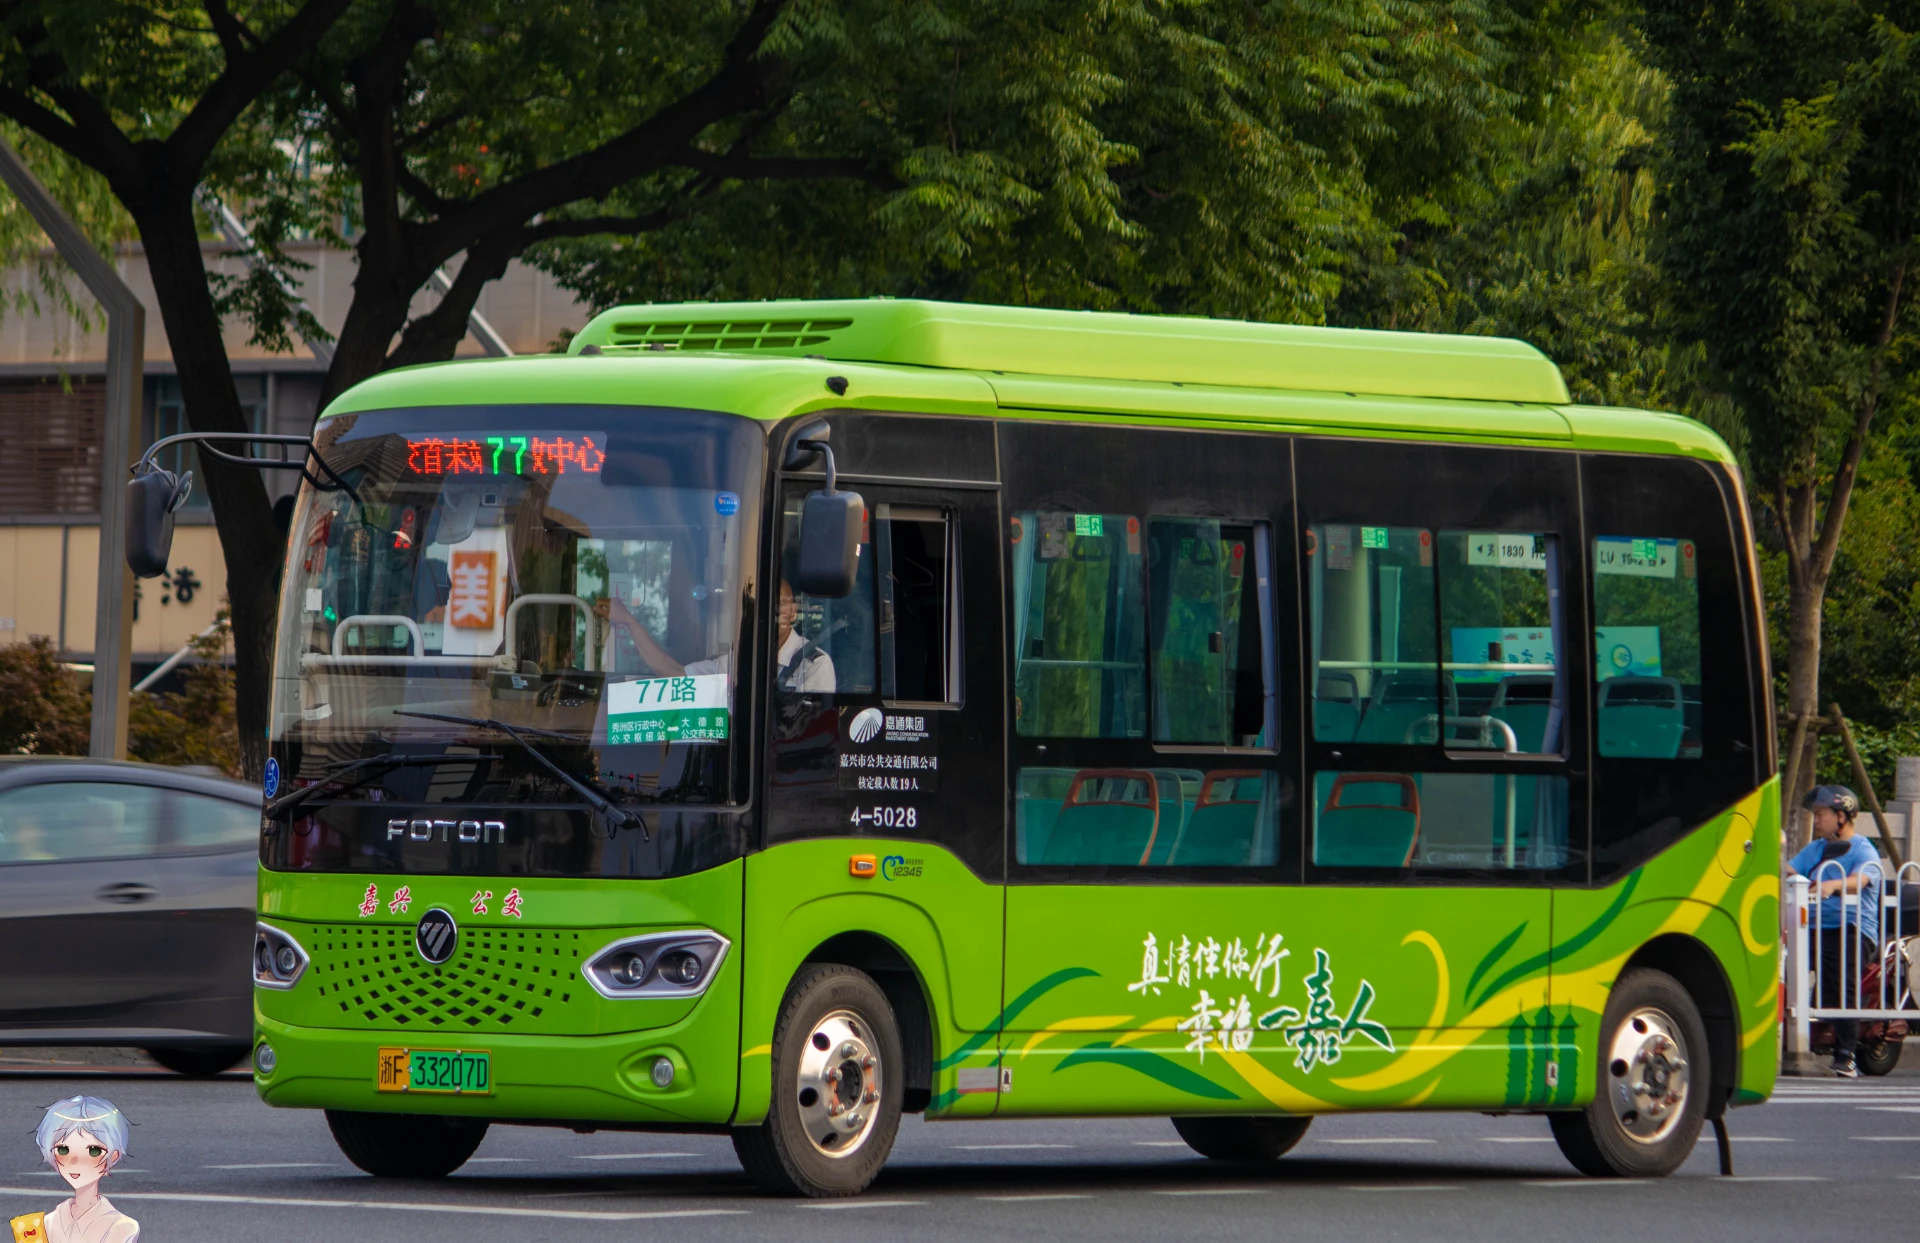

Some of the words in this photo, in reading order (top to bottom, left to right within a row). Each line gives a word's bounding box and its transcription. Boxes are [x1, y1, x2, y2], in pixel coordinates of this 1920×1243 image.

[487, 437, 527, 475] 77
[1502, 545, 1525, 558] 1830
[1600, 549, 1615, 565] LU
[635, 676, 697, 704] 77路
[611, 719, 666, 733] 秀洲区行政中心
[885, 715, 924, 731] 嘉通集团
[611, 731, 666, 744] 公交枢纽站
[681, 729, 725, 740] 公交首末站
[840, 753, 937, 770] 嘉兴市公共交通有限公司
[850, 806, 917, 828] 4-5028
[386, 819, 506, 844] FOTON
[893, 866, 923, 877] 12345
[358, 882, 412, 918] 嘉兴
[469, 887, 524, 919] 公交
[1127, 931, 1291, 998] 真情伴你行
[380, 1055, 405, 1085] 浙F
[414, 1055, 488, 1088] 33207D
